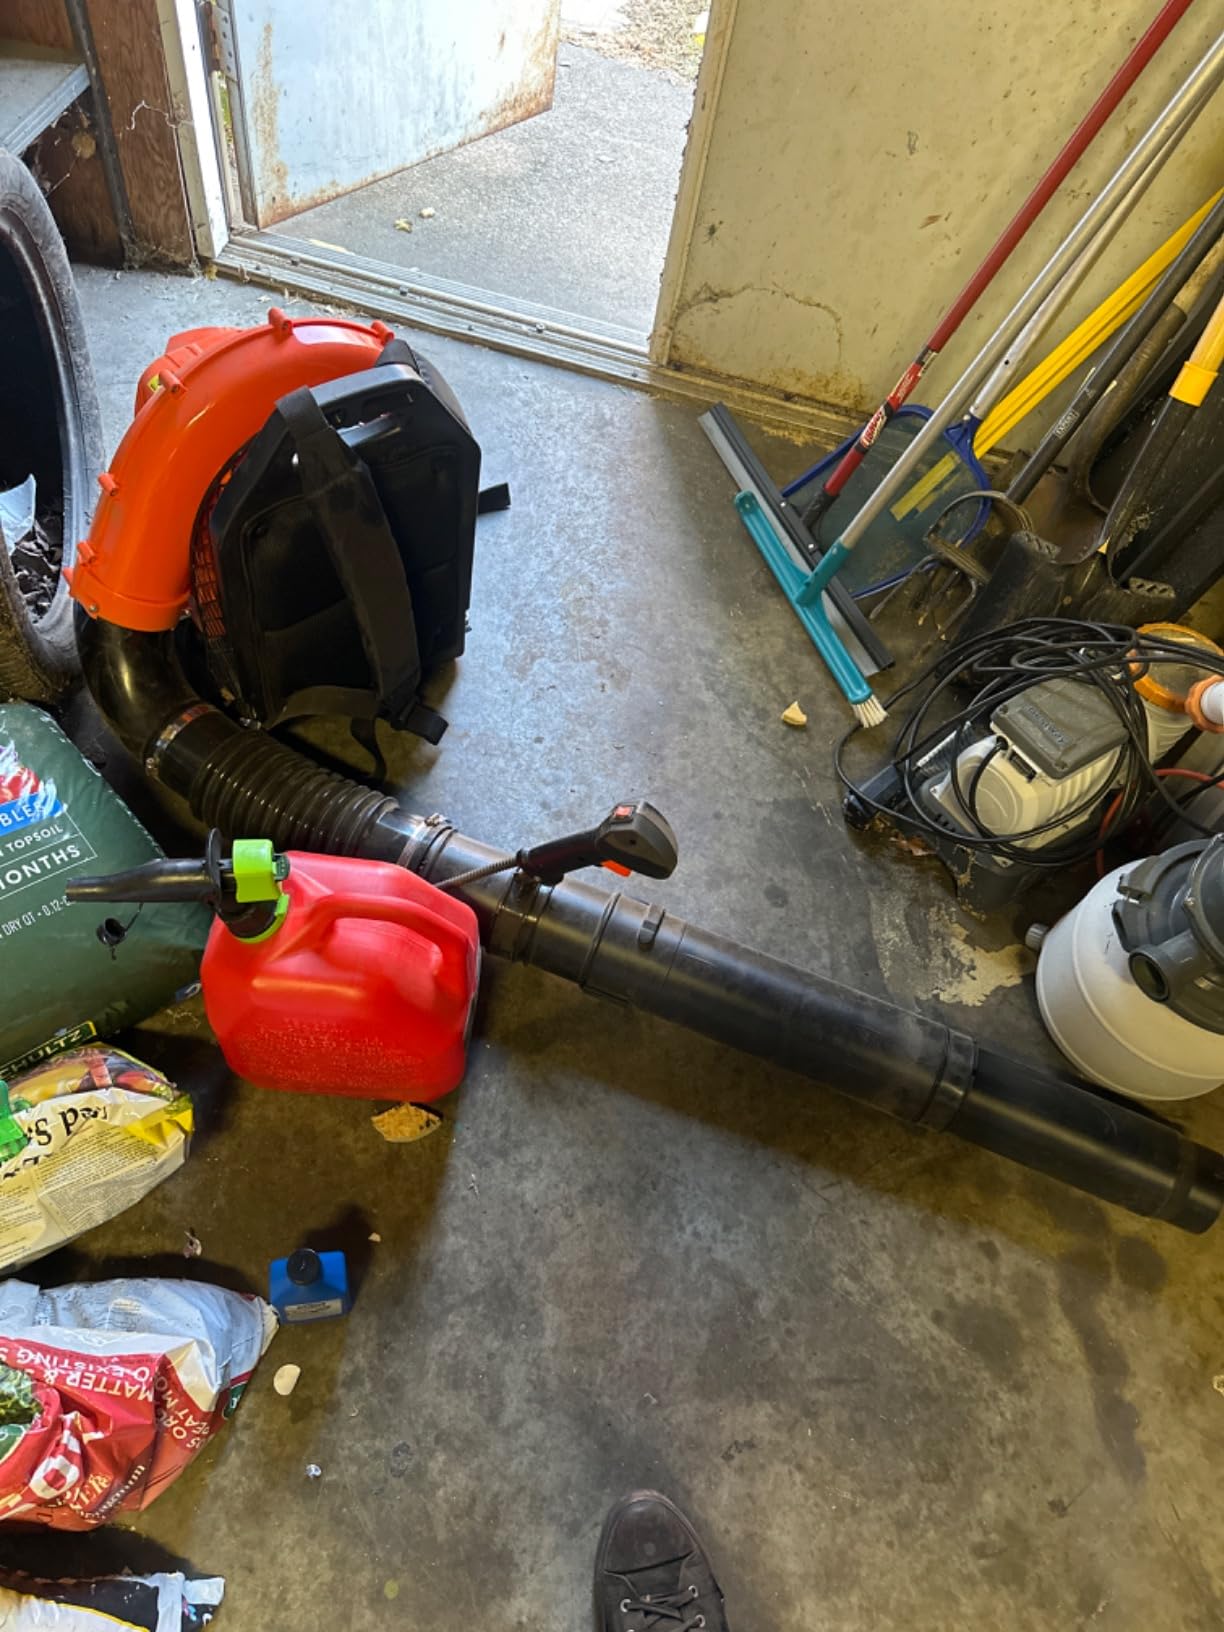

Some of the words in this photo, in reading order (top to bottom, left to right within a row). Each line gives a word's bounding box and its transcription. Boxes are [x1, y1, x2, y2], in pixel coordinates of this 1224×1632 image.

[5, 824, 63, 852] TOPSOIL
[1, 918, 22, 935] DRY
[16, 1347, 125, 1377] EXISTING
[43, 1369, 59, 1385] &
[66, 1370, 154, 1402] MATTER
